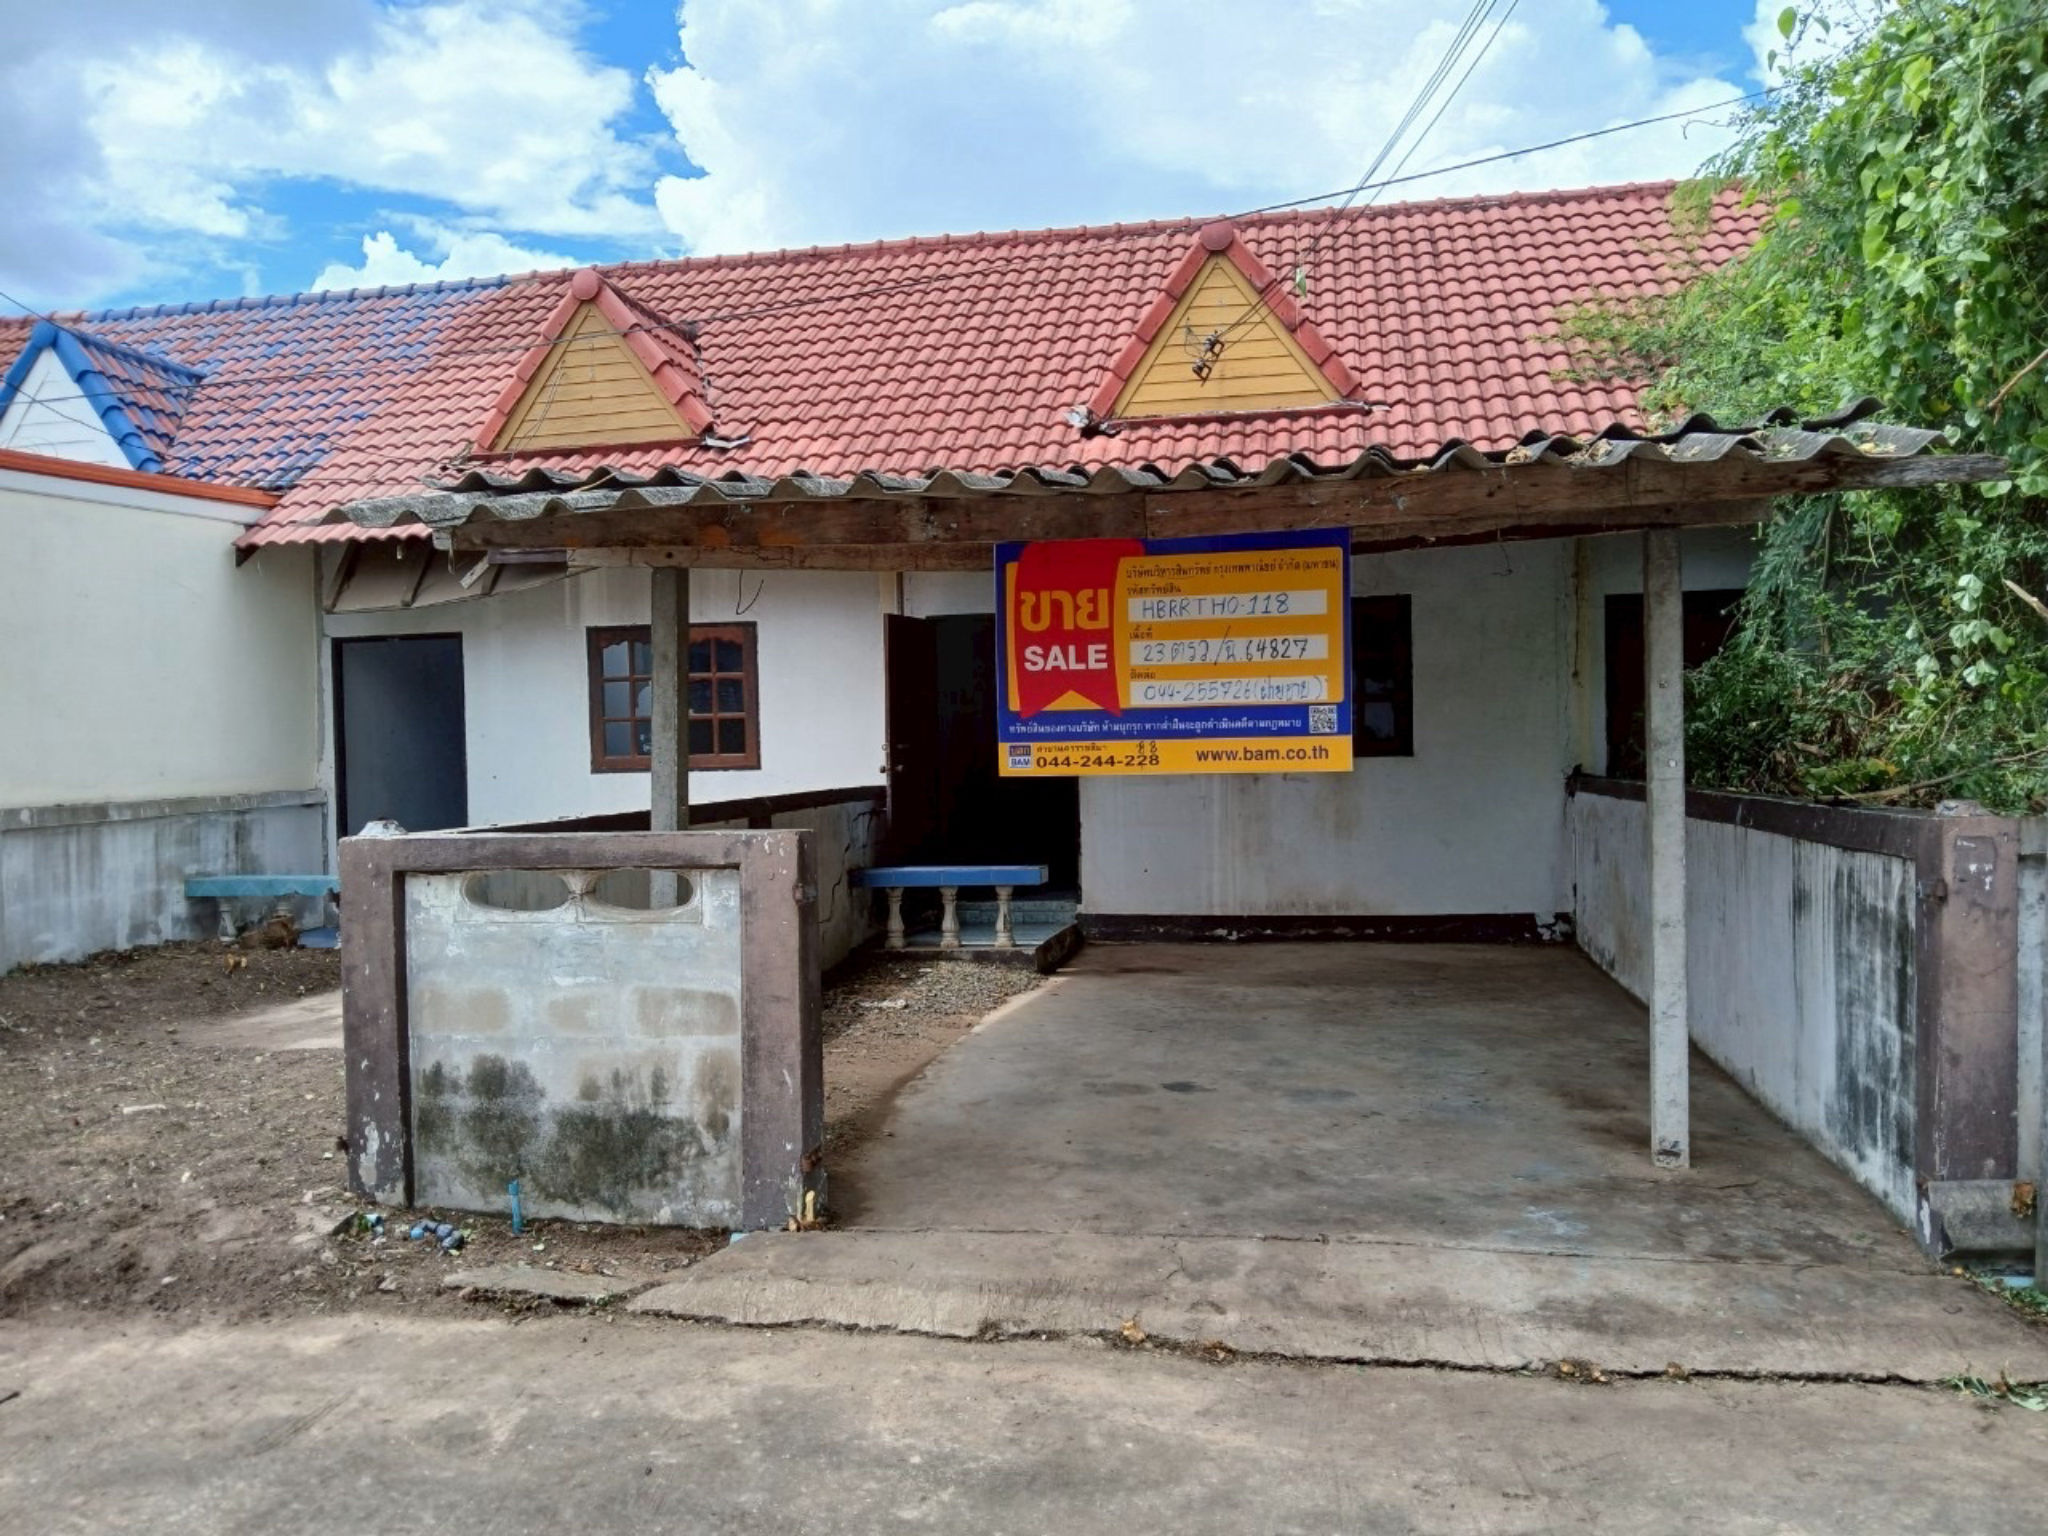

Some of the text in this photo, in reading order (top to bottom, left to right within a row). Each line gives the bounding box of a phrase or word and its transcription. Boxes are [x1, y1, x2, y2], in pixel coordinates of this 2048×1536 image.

[1020, 588, 1110, 632] ขาย
[1024, 643, 1109, 672] SALE
[1010, 757, 1030, 767] BAM
[1036, 754, 1160, 769] 044-244-228
[1196, 744, 1329, 762] www.bam.co.th
